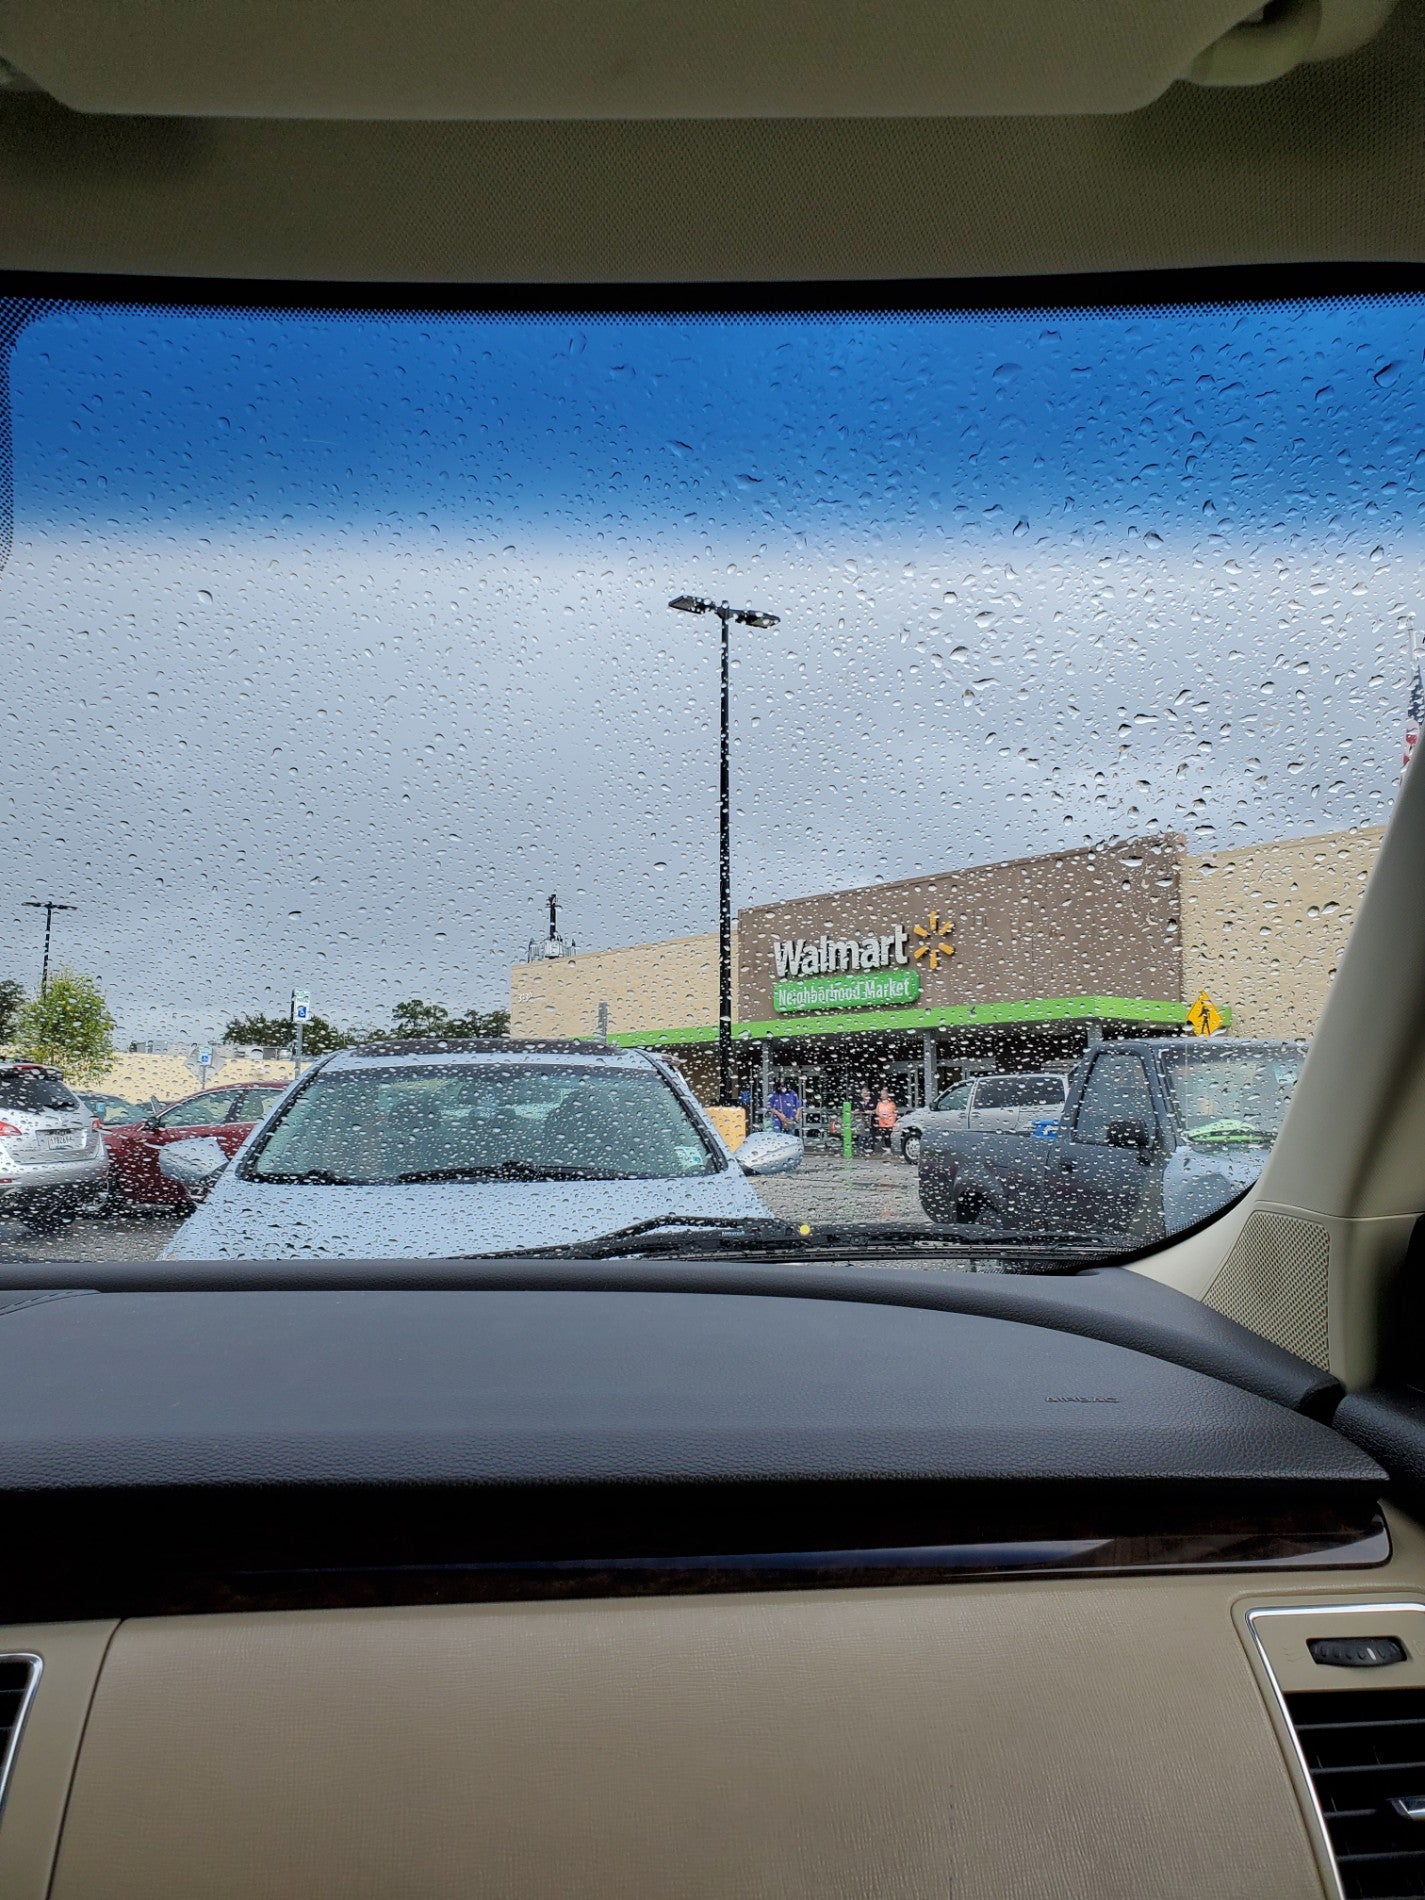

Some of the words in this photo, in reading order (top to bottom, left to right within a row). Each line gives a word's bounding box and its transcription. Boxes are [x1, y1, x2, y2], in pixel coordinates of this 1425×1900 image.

[773, 924, 908, 977] Walmart
[778, 982, 861, 1006] Neighborhood
[864, 978, 910, 999] Market
